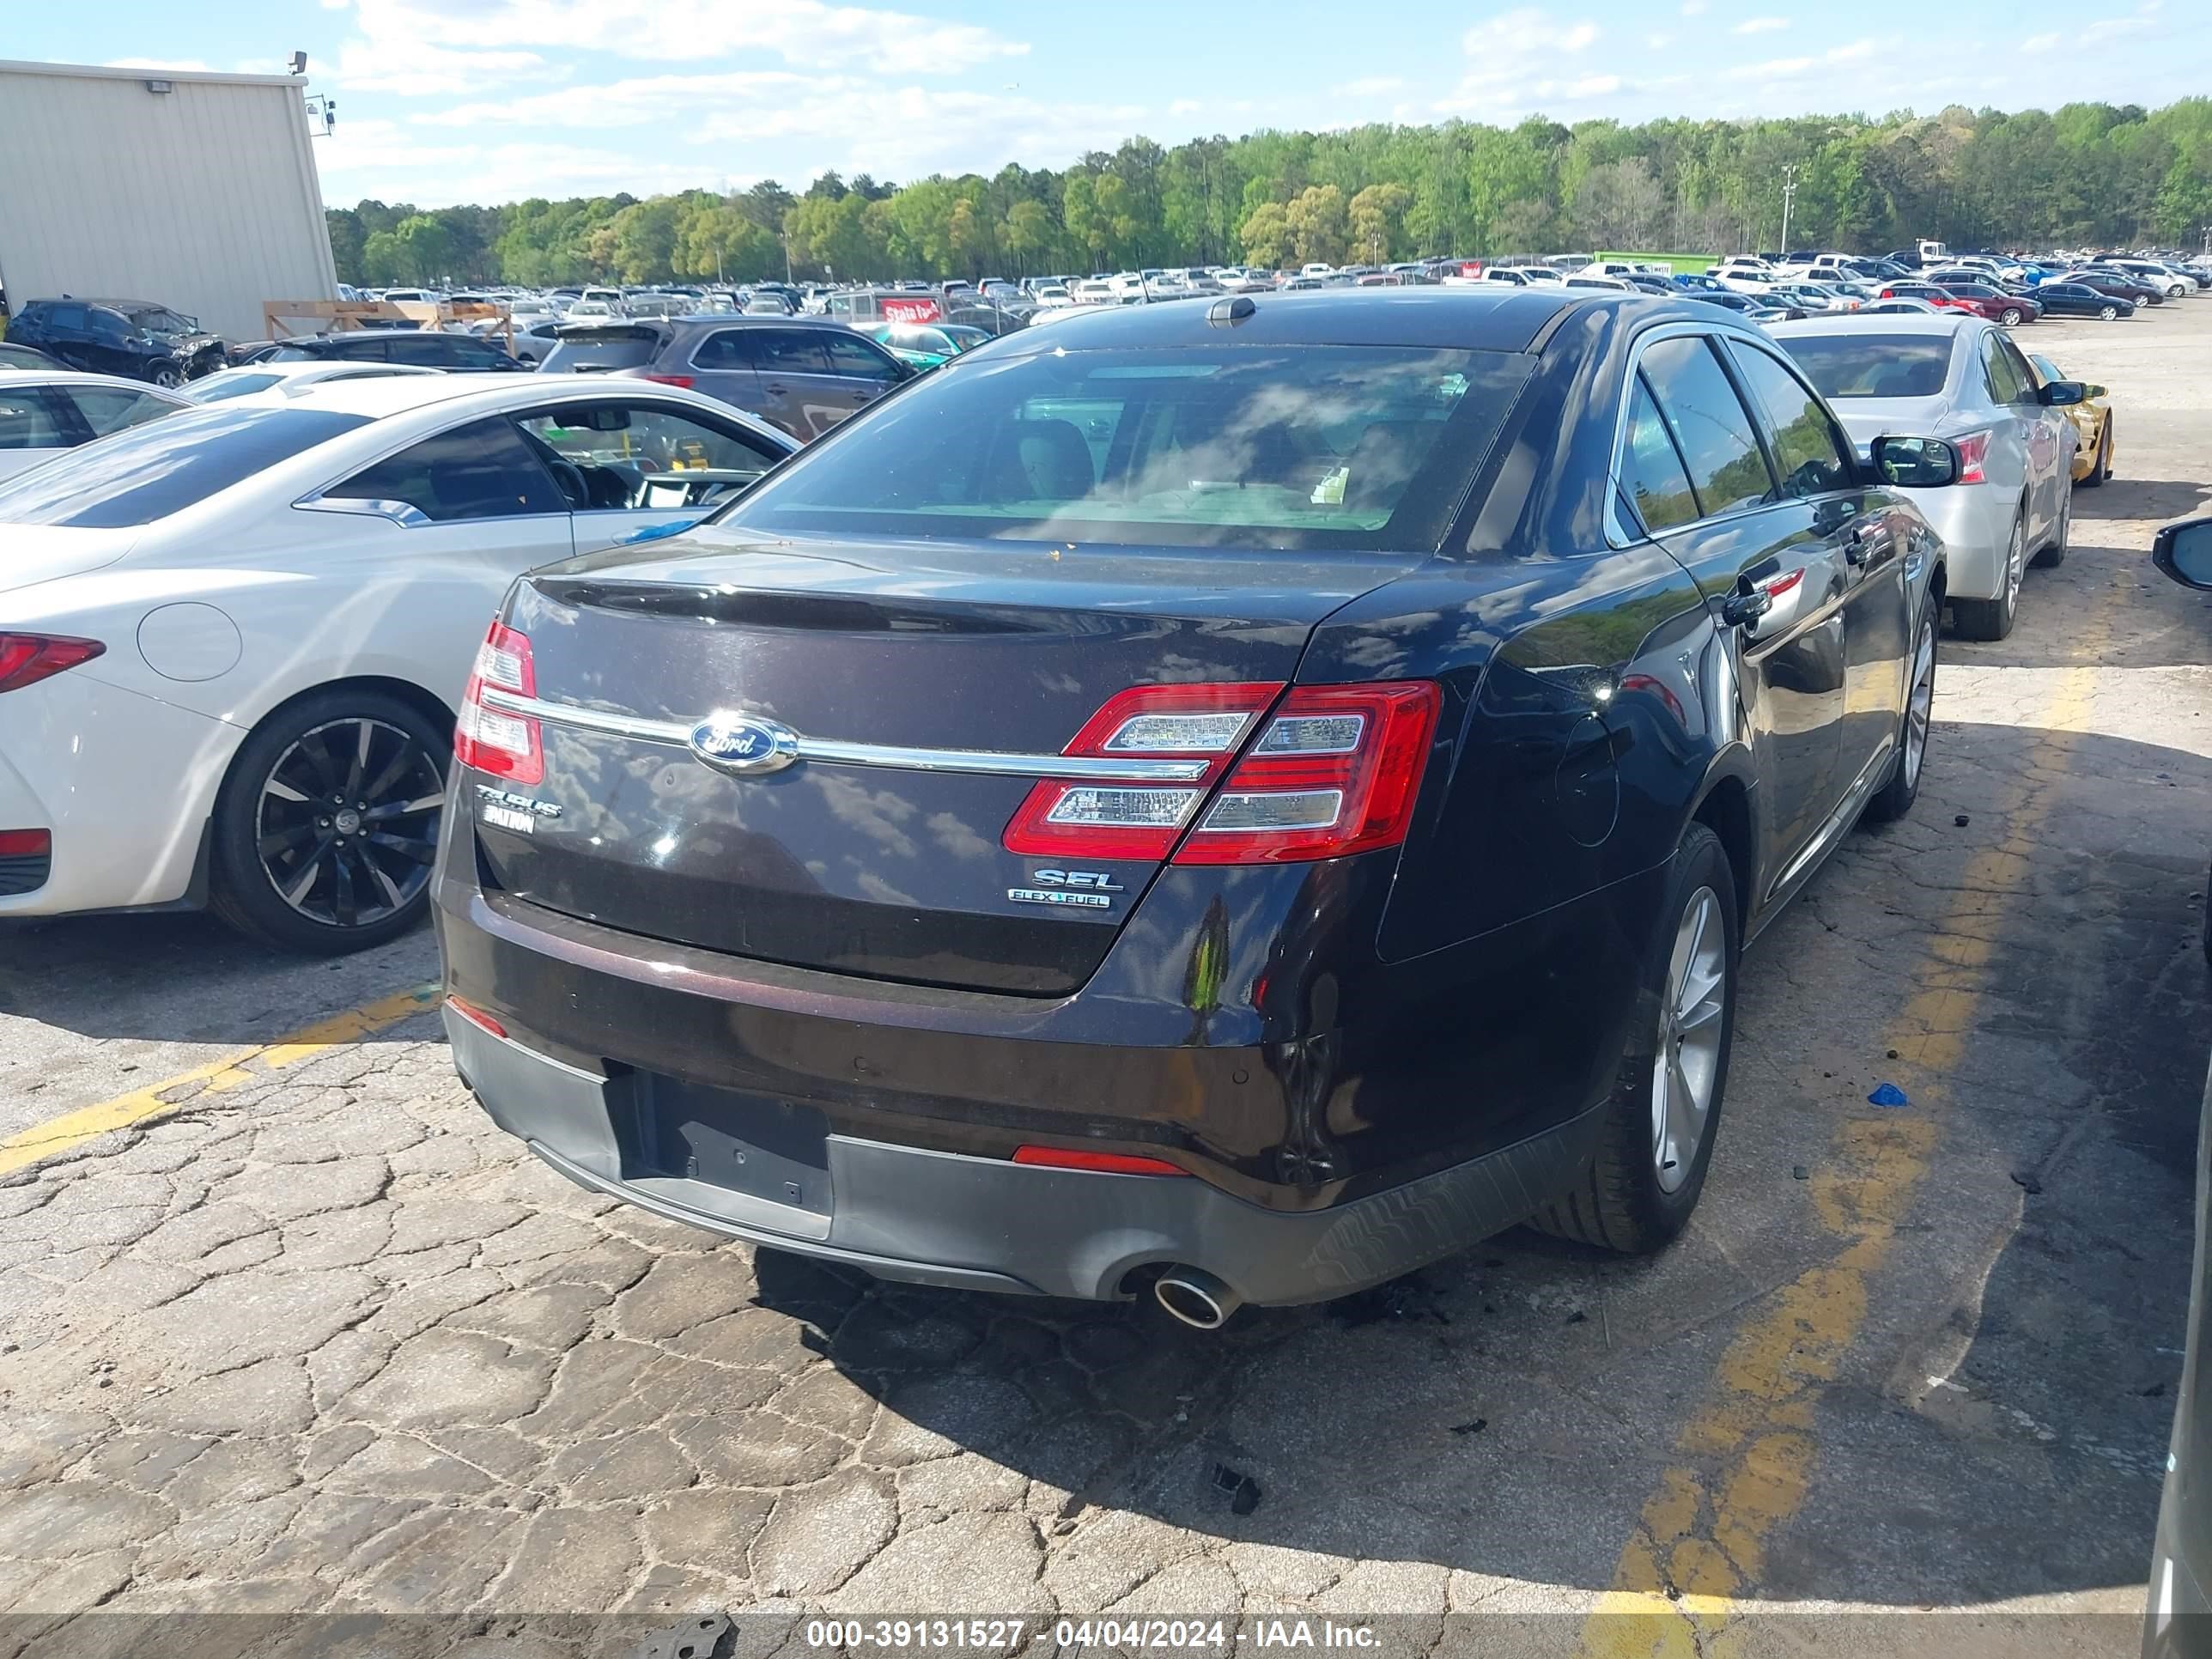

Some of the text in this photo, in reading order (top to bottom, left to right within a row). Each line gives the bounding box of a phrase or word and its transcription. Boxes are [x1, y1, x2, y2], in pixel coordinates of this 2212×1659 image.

[702, 725, 757, 754] Ford
[1032, 868, 1124, 890] SEL
[1012, 890, 1109, 907] FLEX FUEL
